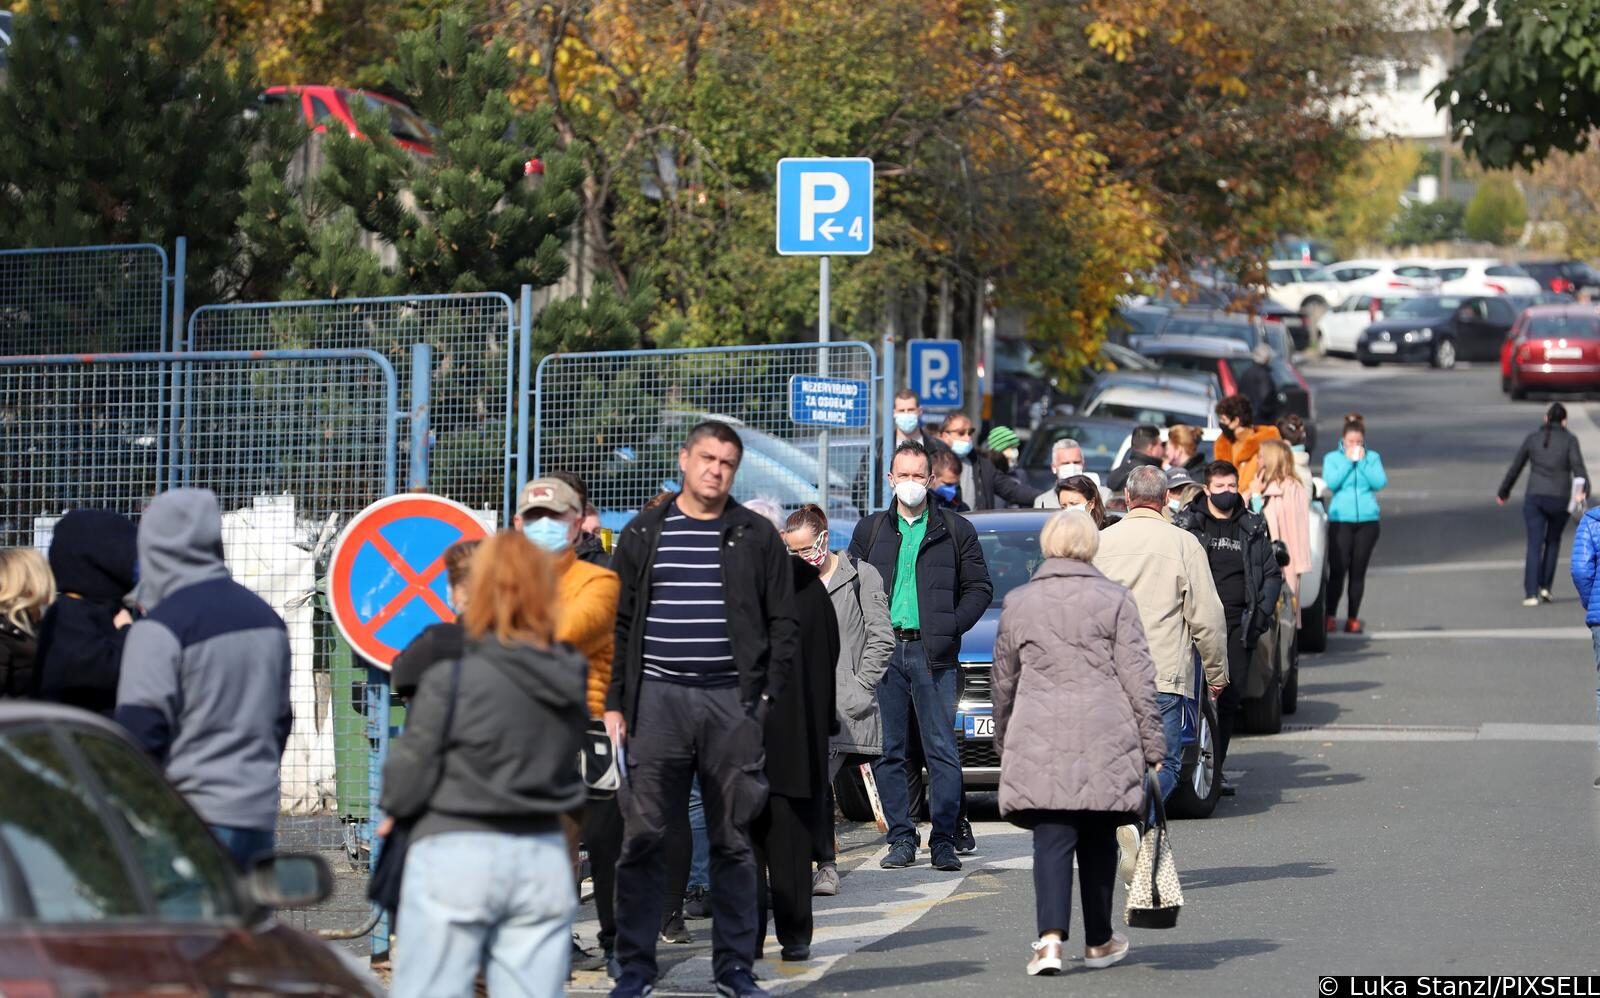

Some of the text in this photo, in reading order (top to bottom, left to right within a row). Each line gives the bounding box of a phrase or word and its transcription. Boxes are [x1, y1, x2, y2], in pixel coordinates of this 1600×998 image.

[800, 171, 863, 241] P 4
[921, 349, 958, 400] P 5
[805, 395, 817, 407] ZA
